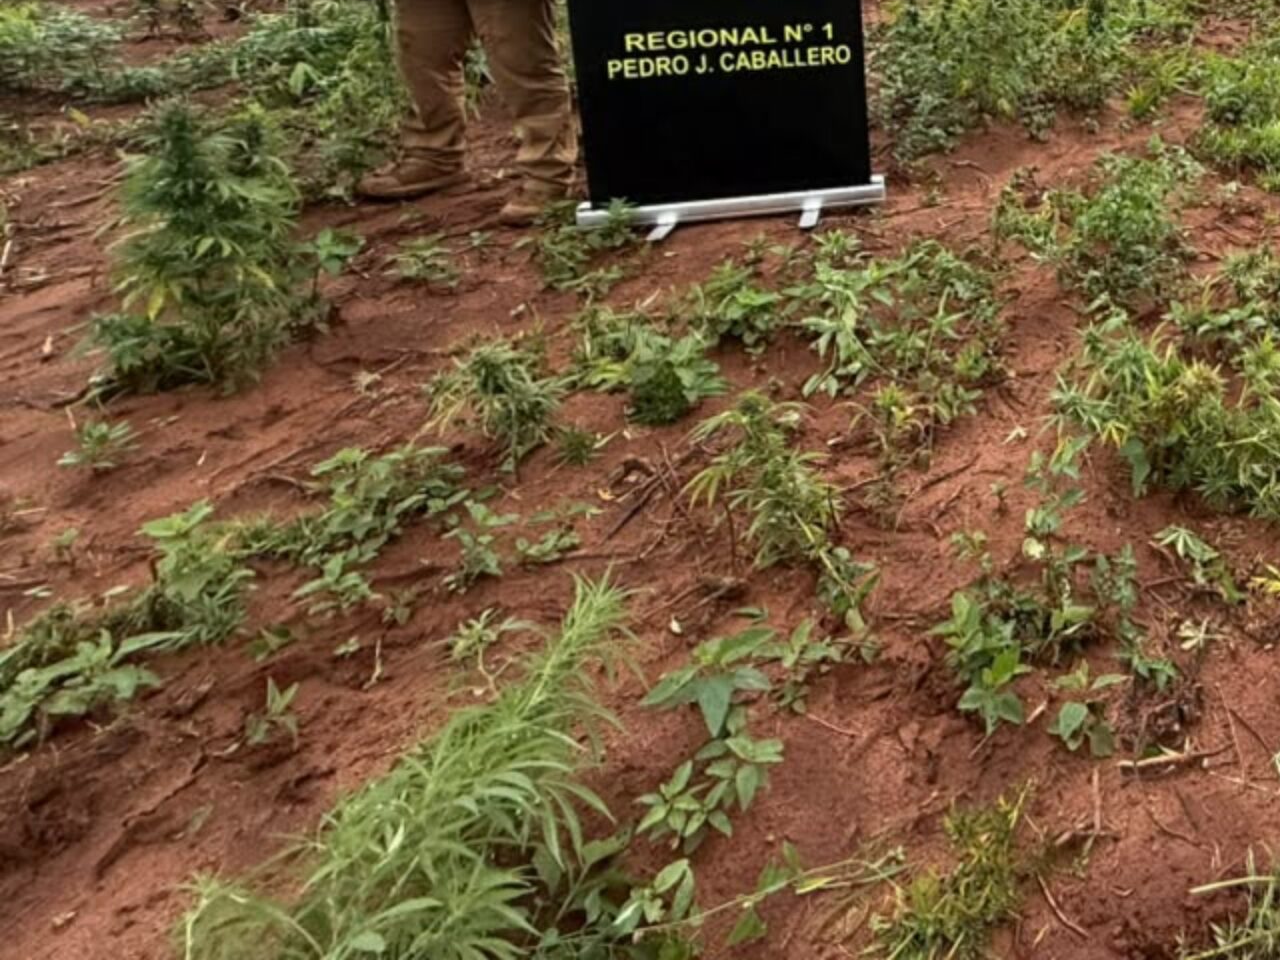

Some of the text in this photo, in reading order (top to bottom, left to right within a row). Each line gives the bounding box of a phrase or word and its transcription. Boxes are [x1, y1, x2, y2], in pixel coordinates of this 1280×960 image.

[624, 26, 777, 52] REGIONAL
[821, 22, 834, 40] 1
[607, 45, 852, 80] PEDRO J. CABALLERO
